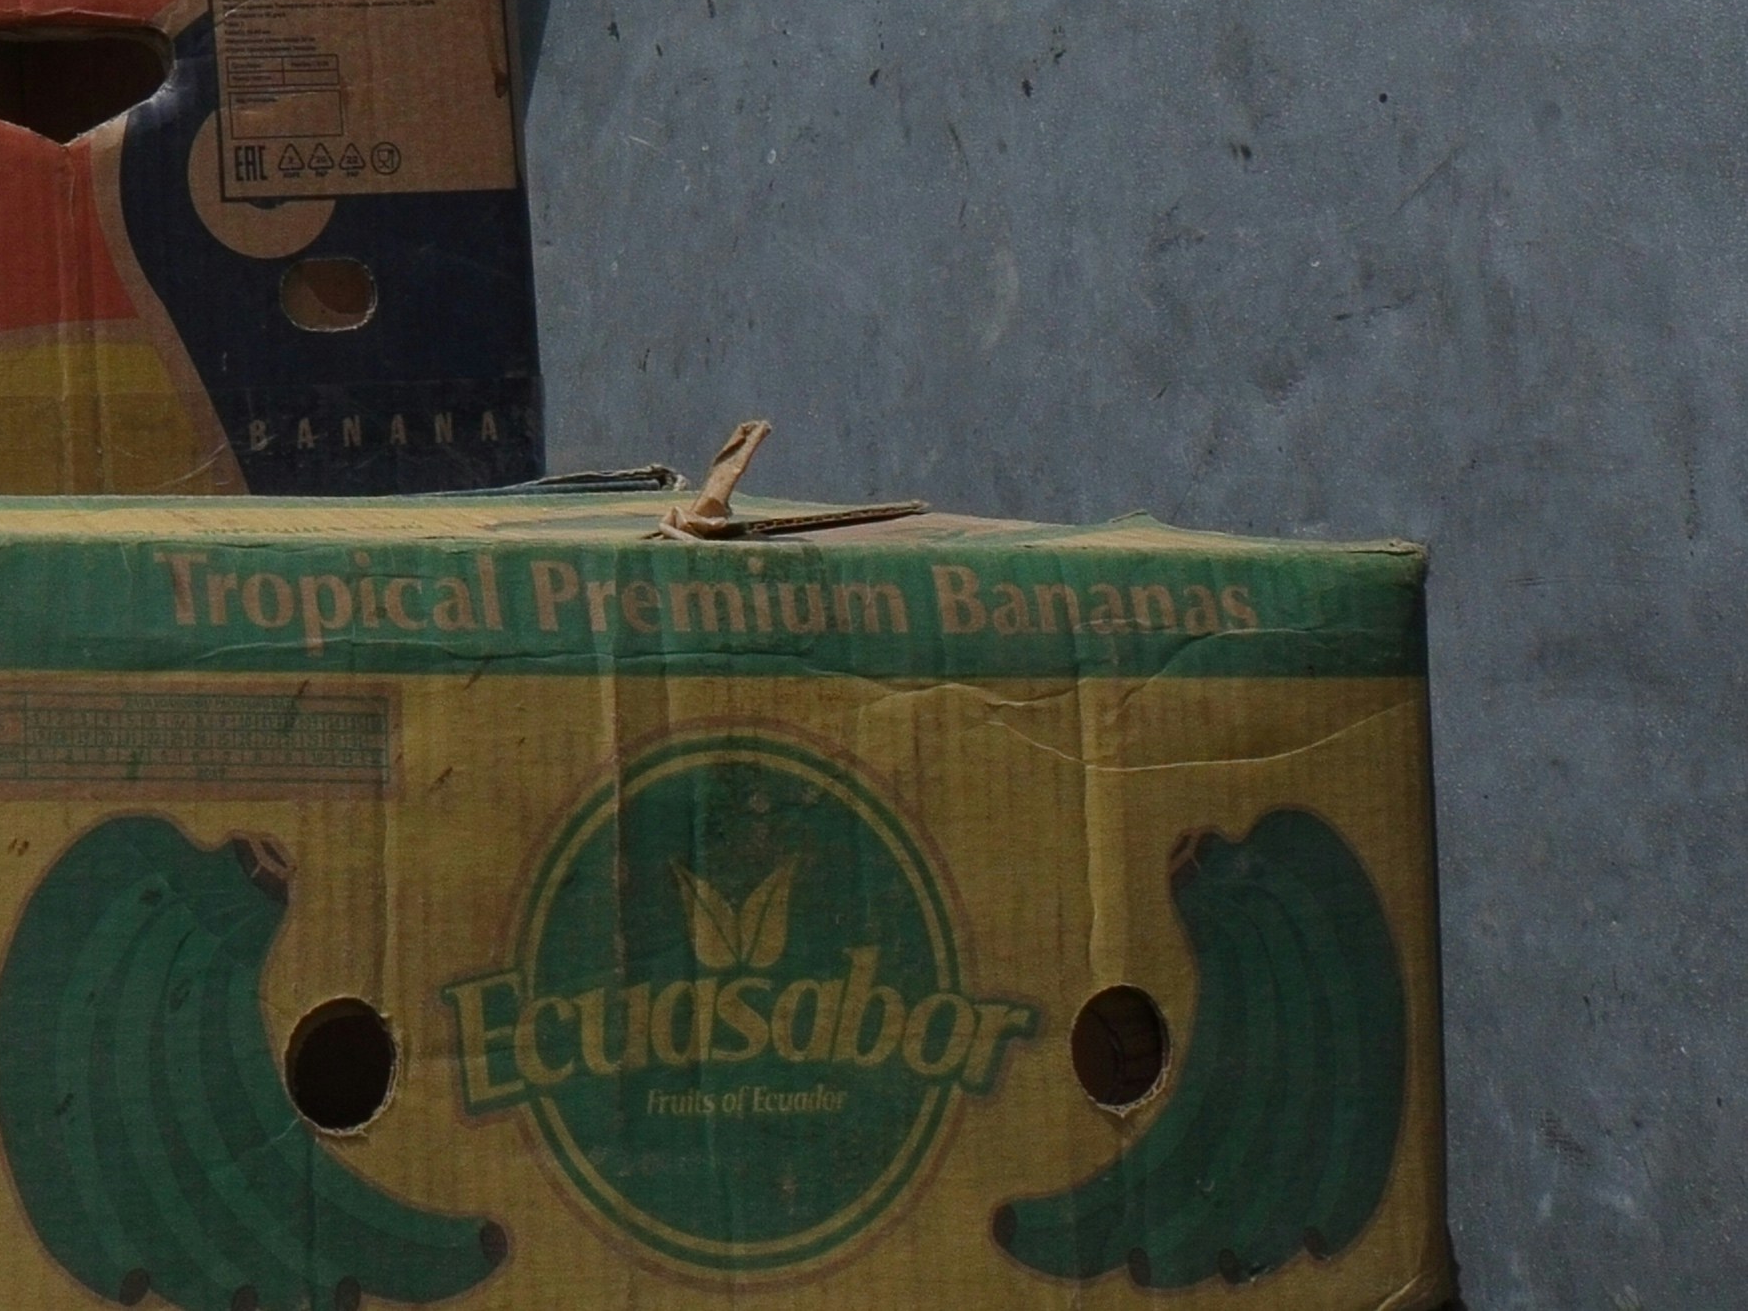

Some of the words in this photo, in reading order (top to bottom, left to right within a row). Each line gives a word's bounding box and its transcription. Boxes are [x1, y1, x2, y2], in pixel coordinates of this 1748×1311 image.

[153, 551, 502, 655] Tropical
[534, 557, 908, 635] Premium
[930, 564, 1261, 636] Bananas
[445, 945, 1030, 1104] Ecuasabor
[646, 1087, 716, 1116] Fruits
[721, 1084, 750, 1117] of
[752, 1083, 848, 1114] Ecuador
